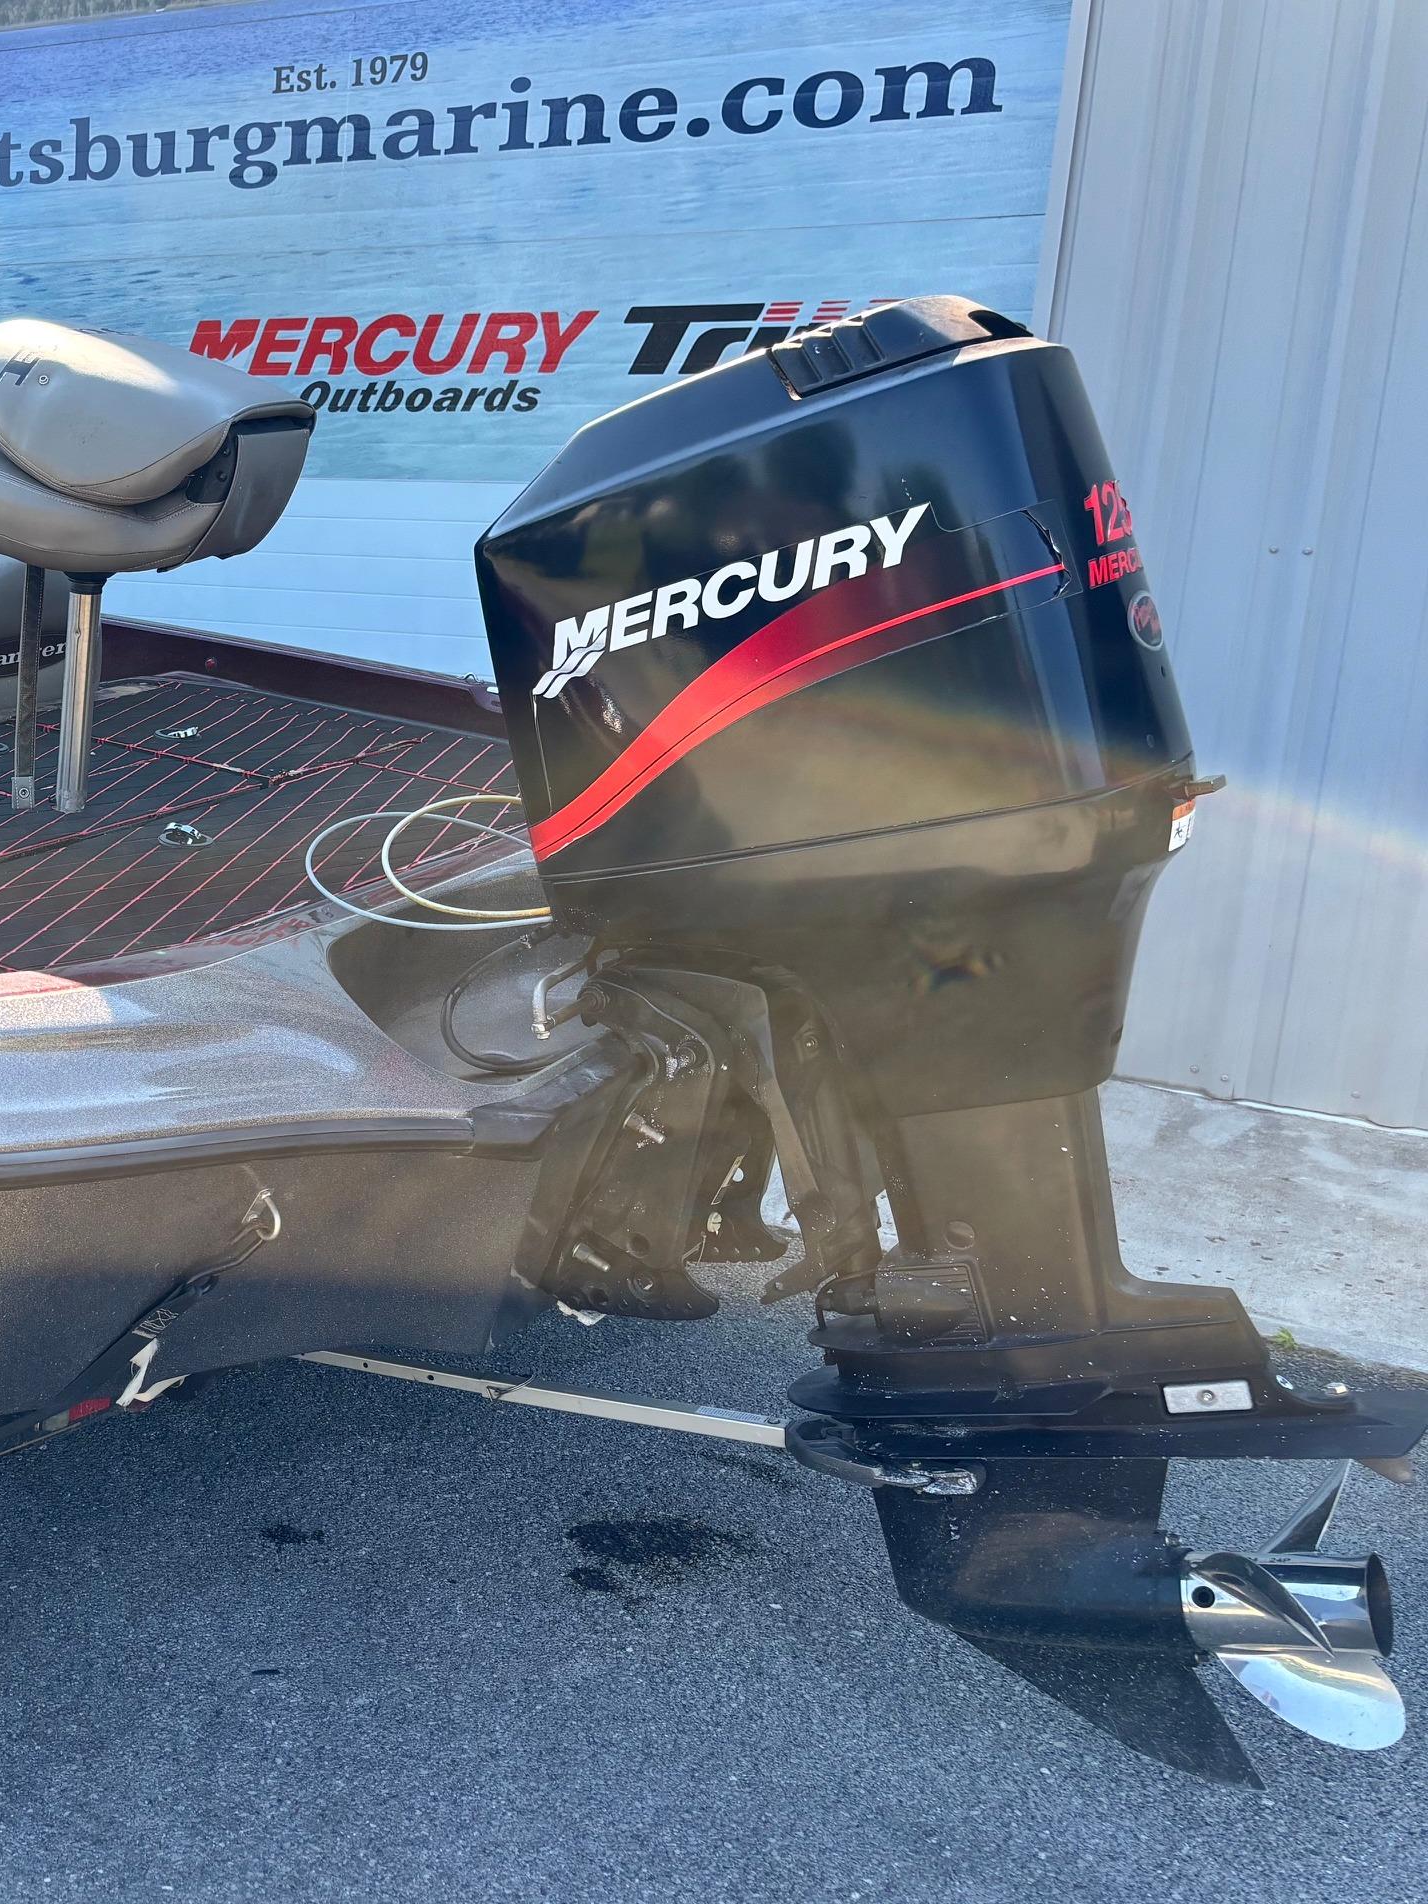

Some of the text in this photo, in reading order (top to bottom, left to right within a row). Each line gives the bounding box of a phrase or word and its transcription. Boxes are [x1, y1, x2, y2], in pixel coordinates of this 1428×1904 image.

[273, 51, 429, 94] Est. 1979
[189, 310, 600, 376] MERCURY
[300, 379, 542, 413] Outboards
[533, 502, 931, 699] MERCURY
